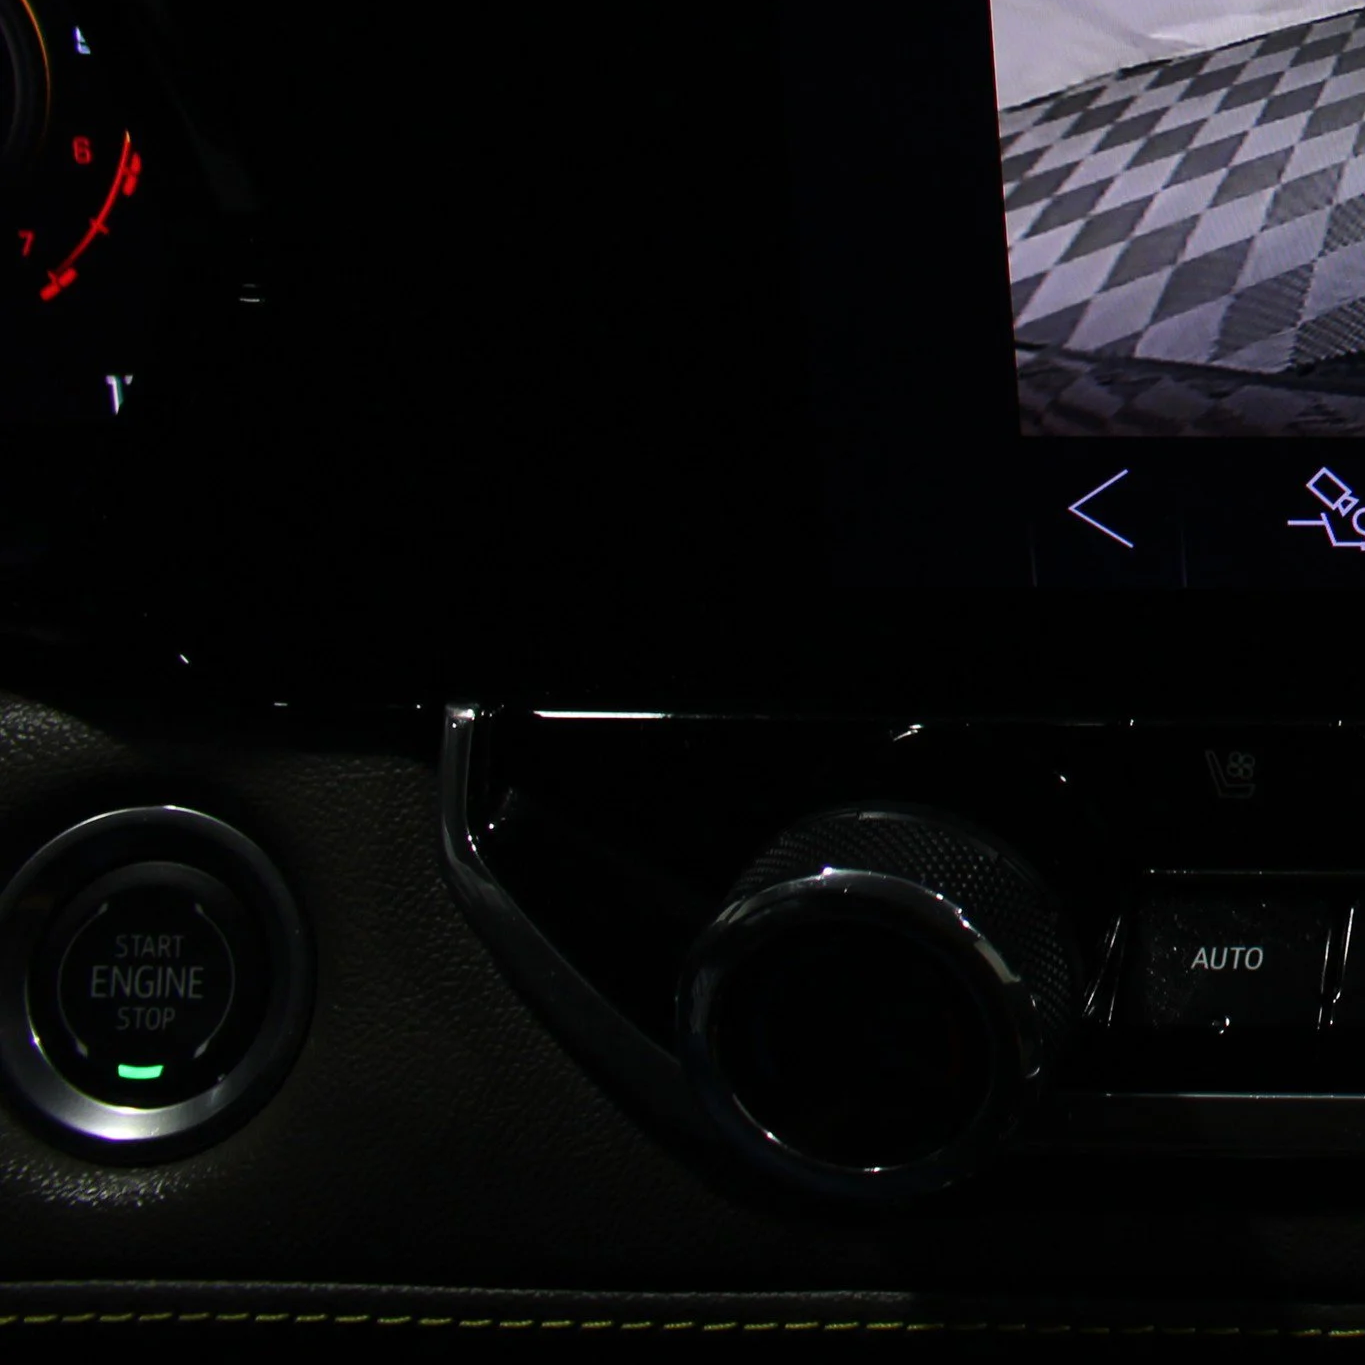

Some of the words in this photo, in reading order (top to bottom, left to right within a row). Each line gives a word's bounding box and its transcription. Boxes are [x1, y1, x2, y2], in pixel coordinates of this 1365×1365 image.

[73, 136, 92, 164] 6
[18, 229, 35, 256] 7
[115, 934, 185, 959] START
[1190, 946, 1264, 970] AUTO
[90, 965, 205, 999] ENGINE
[115, 1006, 176, 1031] STOP
